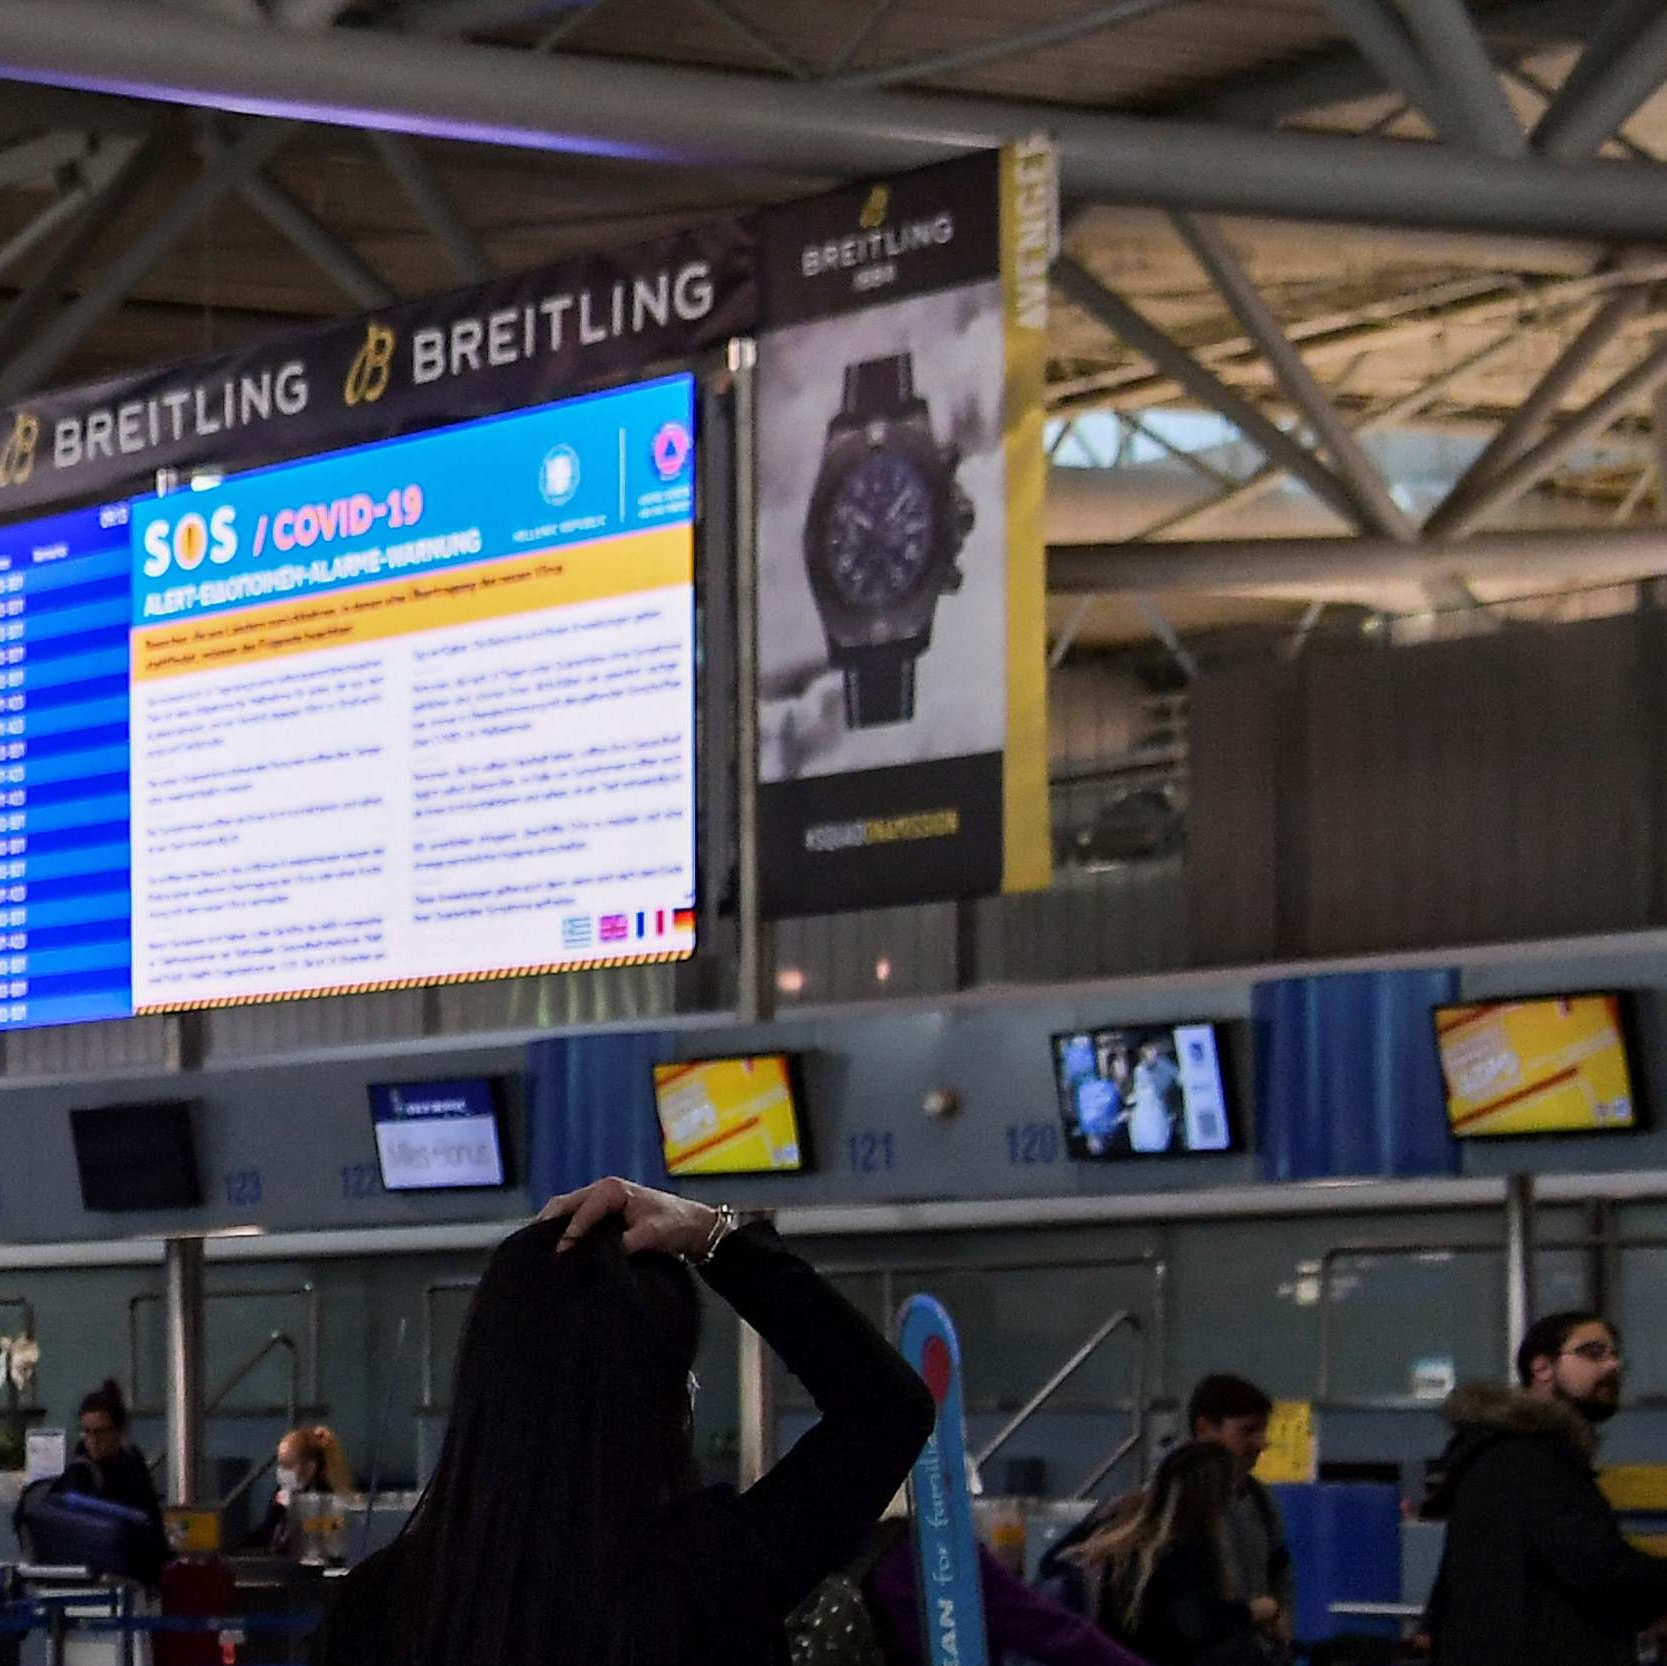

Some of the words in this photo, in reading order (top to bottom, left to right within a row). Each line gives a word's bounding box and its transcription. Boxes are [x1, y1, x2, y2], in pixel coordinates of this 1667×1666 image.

[801, 211, 954, 276] BREITLING
[412, 262, 715, 384] BREITLING
[54, 362, 308, 469] BREITLING
[143, 505, 238, 577] SOS
[849, 1131, 893, 1172] 121
[1005, 1123, 1058, 1165] 120
[931, 1541, 955, 1586] for
